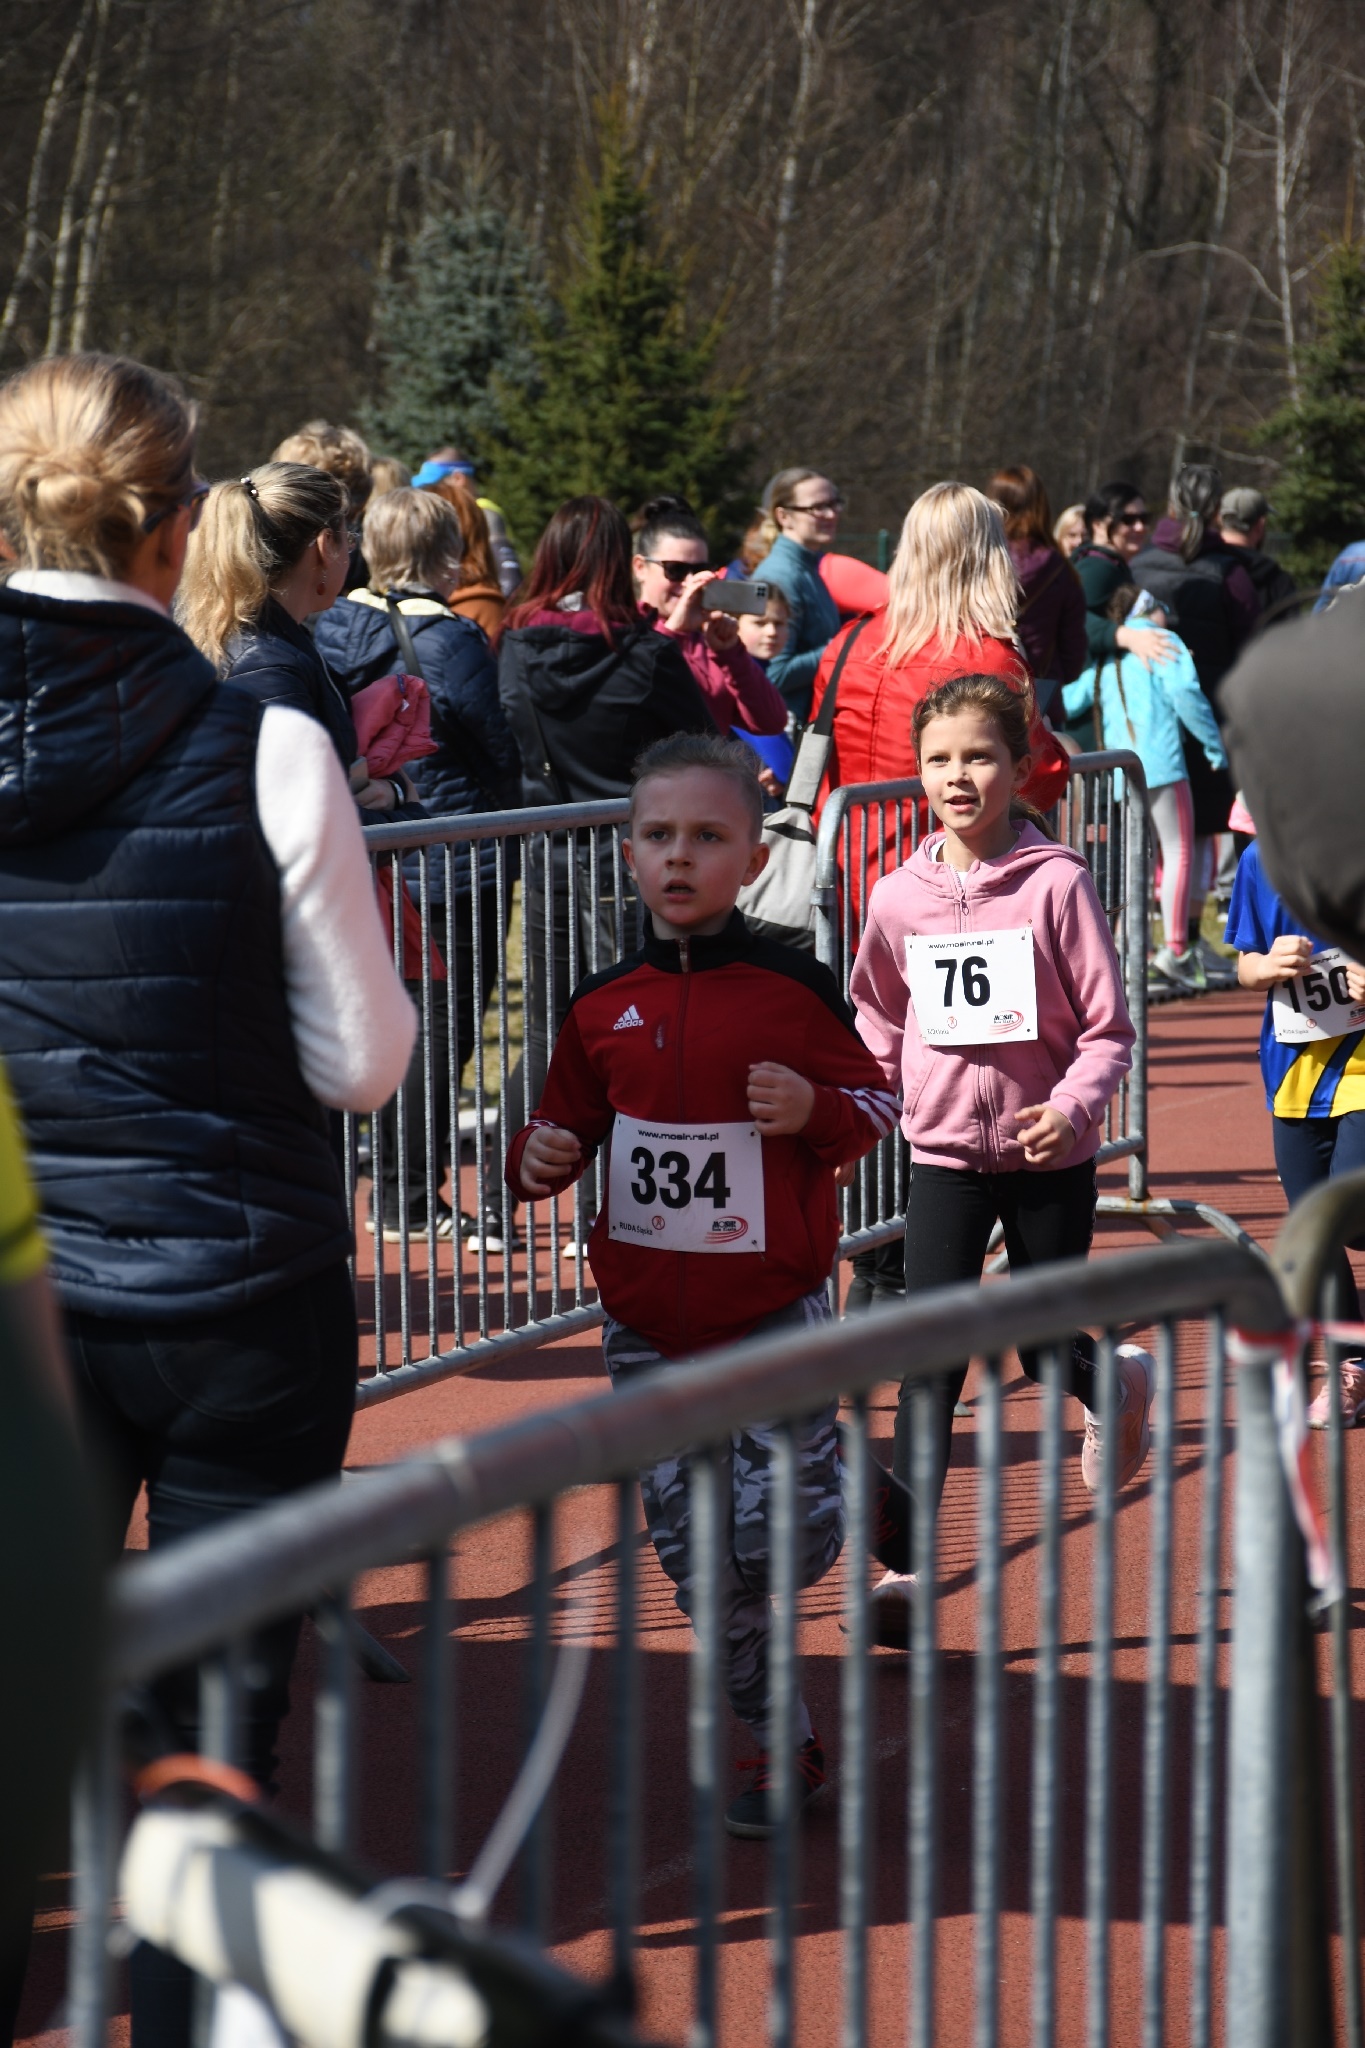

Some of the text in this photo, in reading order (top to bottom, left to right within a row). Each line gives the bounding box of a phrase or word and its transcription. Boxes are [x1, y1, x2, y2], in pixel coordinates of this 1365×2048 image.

[934, 955, 991, 1007] 76
[1282, 967, 1354, 1013] 150
[613, 1018, 644, 1031] adidas
[638, 1129, 719, 1141] www.mosir.rsl.pl
[630, 1146, 731, 1209] 334
[619, 1221, 636, 1233] RUDA
